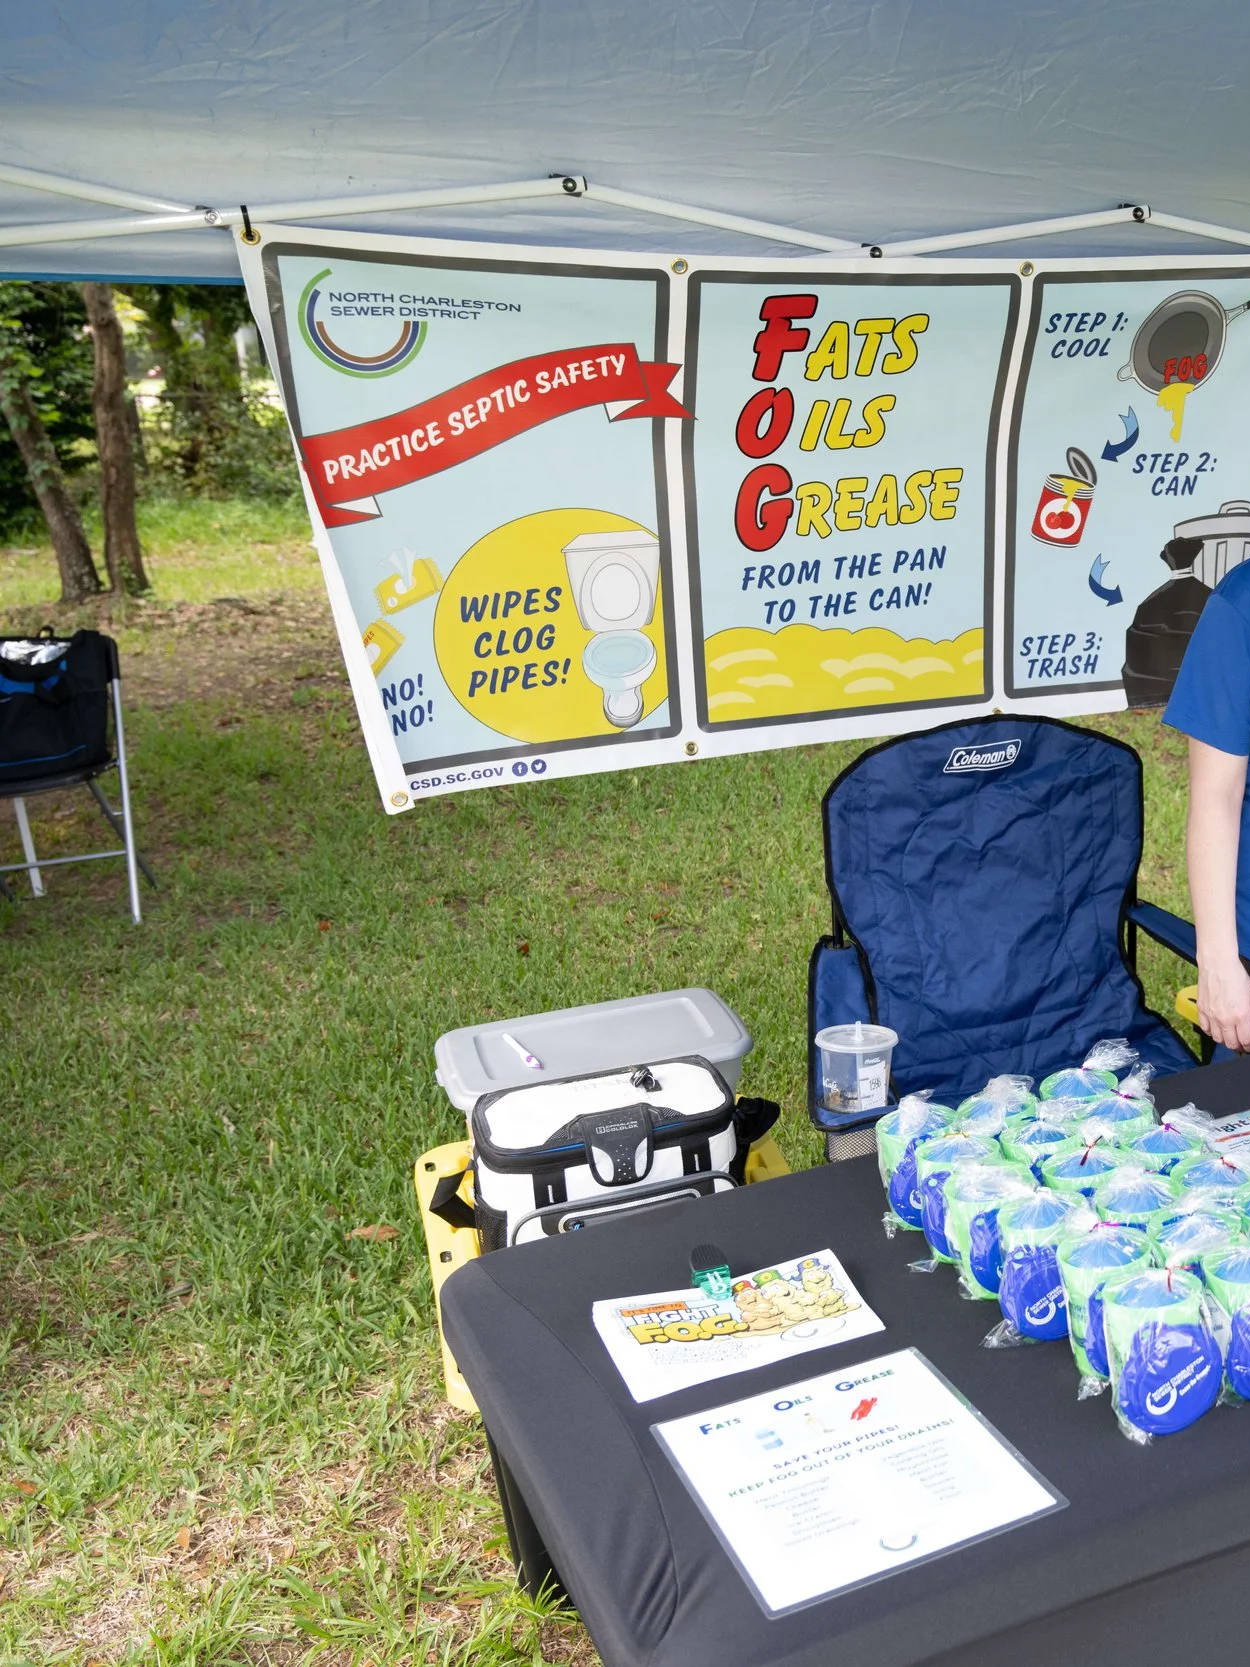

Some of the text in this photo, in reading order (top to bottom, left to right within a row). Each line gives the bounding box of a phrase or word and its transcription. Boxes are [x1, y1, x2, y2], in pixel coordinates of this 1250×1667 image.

[329, 292, 522, 313] NORTH CHARLESTON
[330, 305, 481, 320] SEWER DISTRICT
[751, 293, 930, 382] FATS
[1045, 312, 1129, 335] STEP 1:
[1050, 337, 1111, 360] COOL
[1163, 353, 1208, 384] FOG
[322, 353, 626, 485] PRACTICE SEPTIC SAFETY
[735, 386, 897, 460] OILS
[1132, 452, 1219, 475] STEP 2:
[1151, 474, 1199, 497] CAN
[734, 462, 964, 553] GREASE
[741, 545, 948, 591] FROM THE PAN
[460, 586, 562, 623] WIPES
[764, 582, 933, 625] TO THE CAN!
[473, 624, 556, 659] CLOG
[1020, 631, 1103, 656] STEP 3:
[468, 658, 571, 698] PIPES!
[1027, 653, 1099, 679] TRASH
[381, 673, 424, 710] NO!
[391, 699, 434, 736] NO!
[953, 750, 1005, 767] Coleman
[409, 766, 505, 791] CSD.SC.GOV
[627, 1313, 750, 1345] F.O.G.
[631, 1303, 720, 1325] FIGHT
[699, 1368, 895, 1435] FATS OILS GREASE
[728, 1418, 955, 1498] KEEP FOG OUT OF YOUR DRAINS!
[773, 1424, 900, 1470] SAVE YOUR PIPES!
